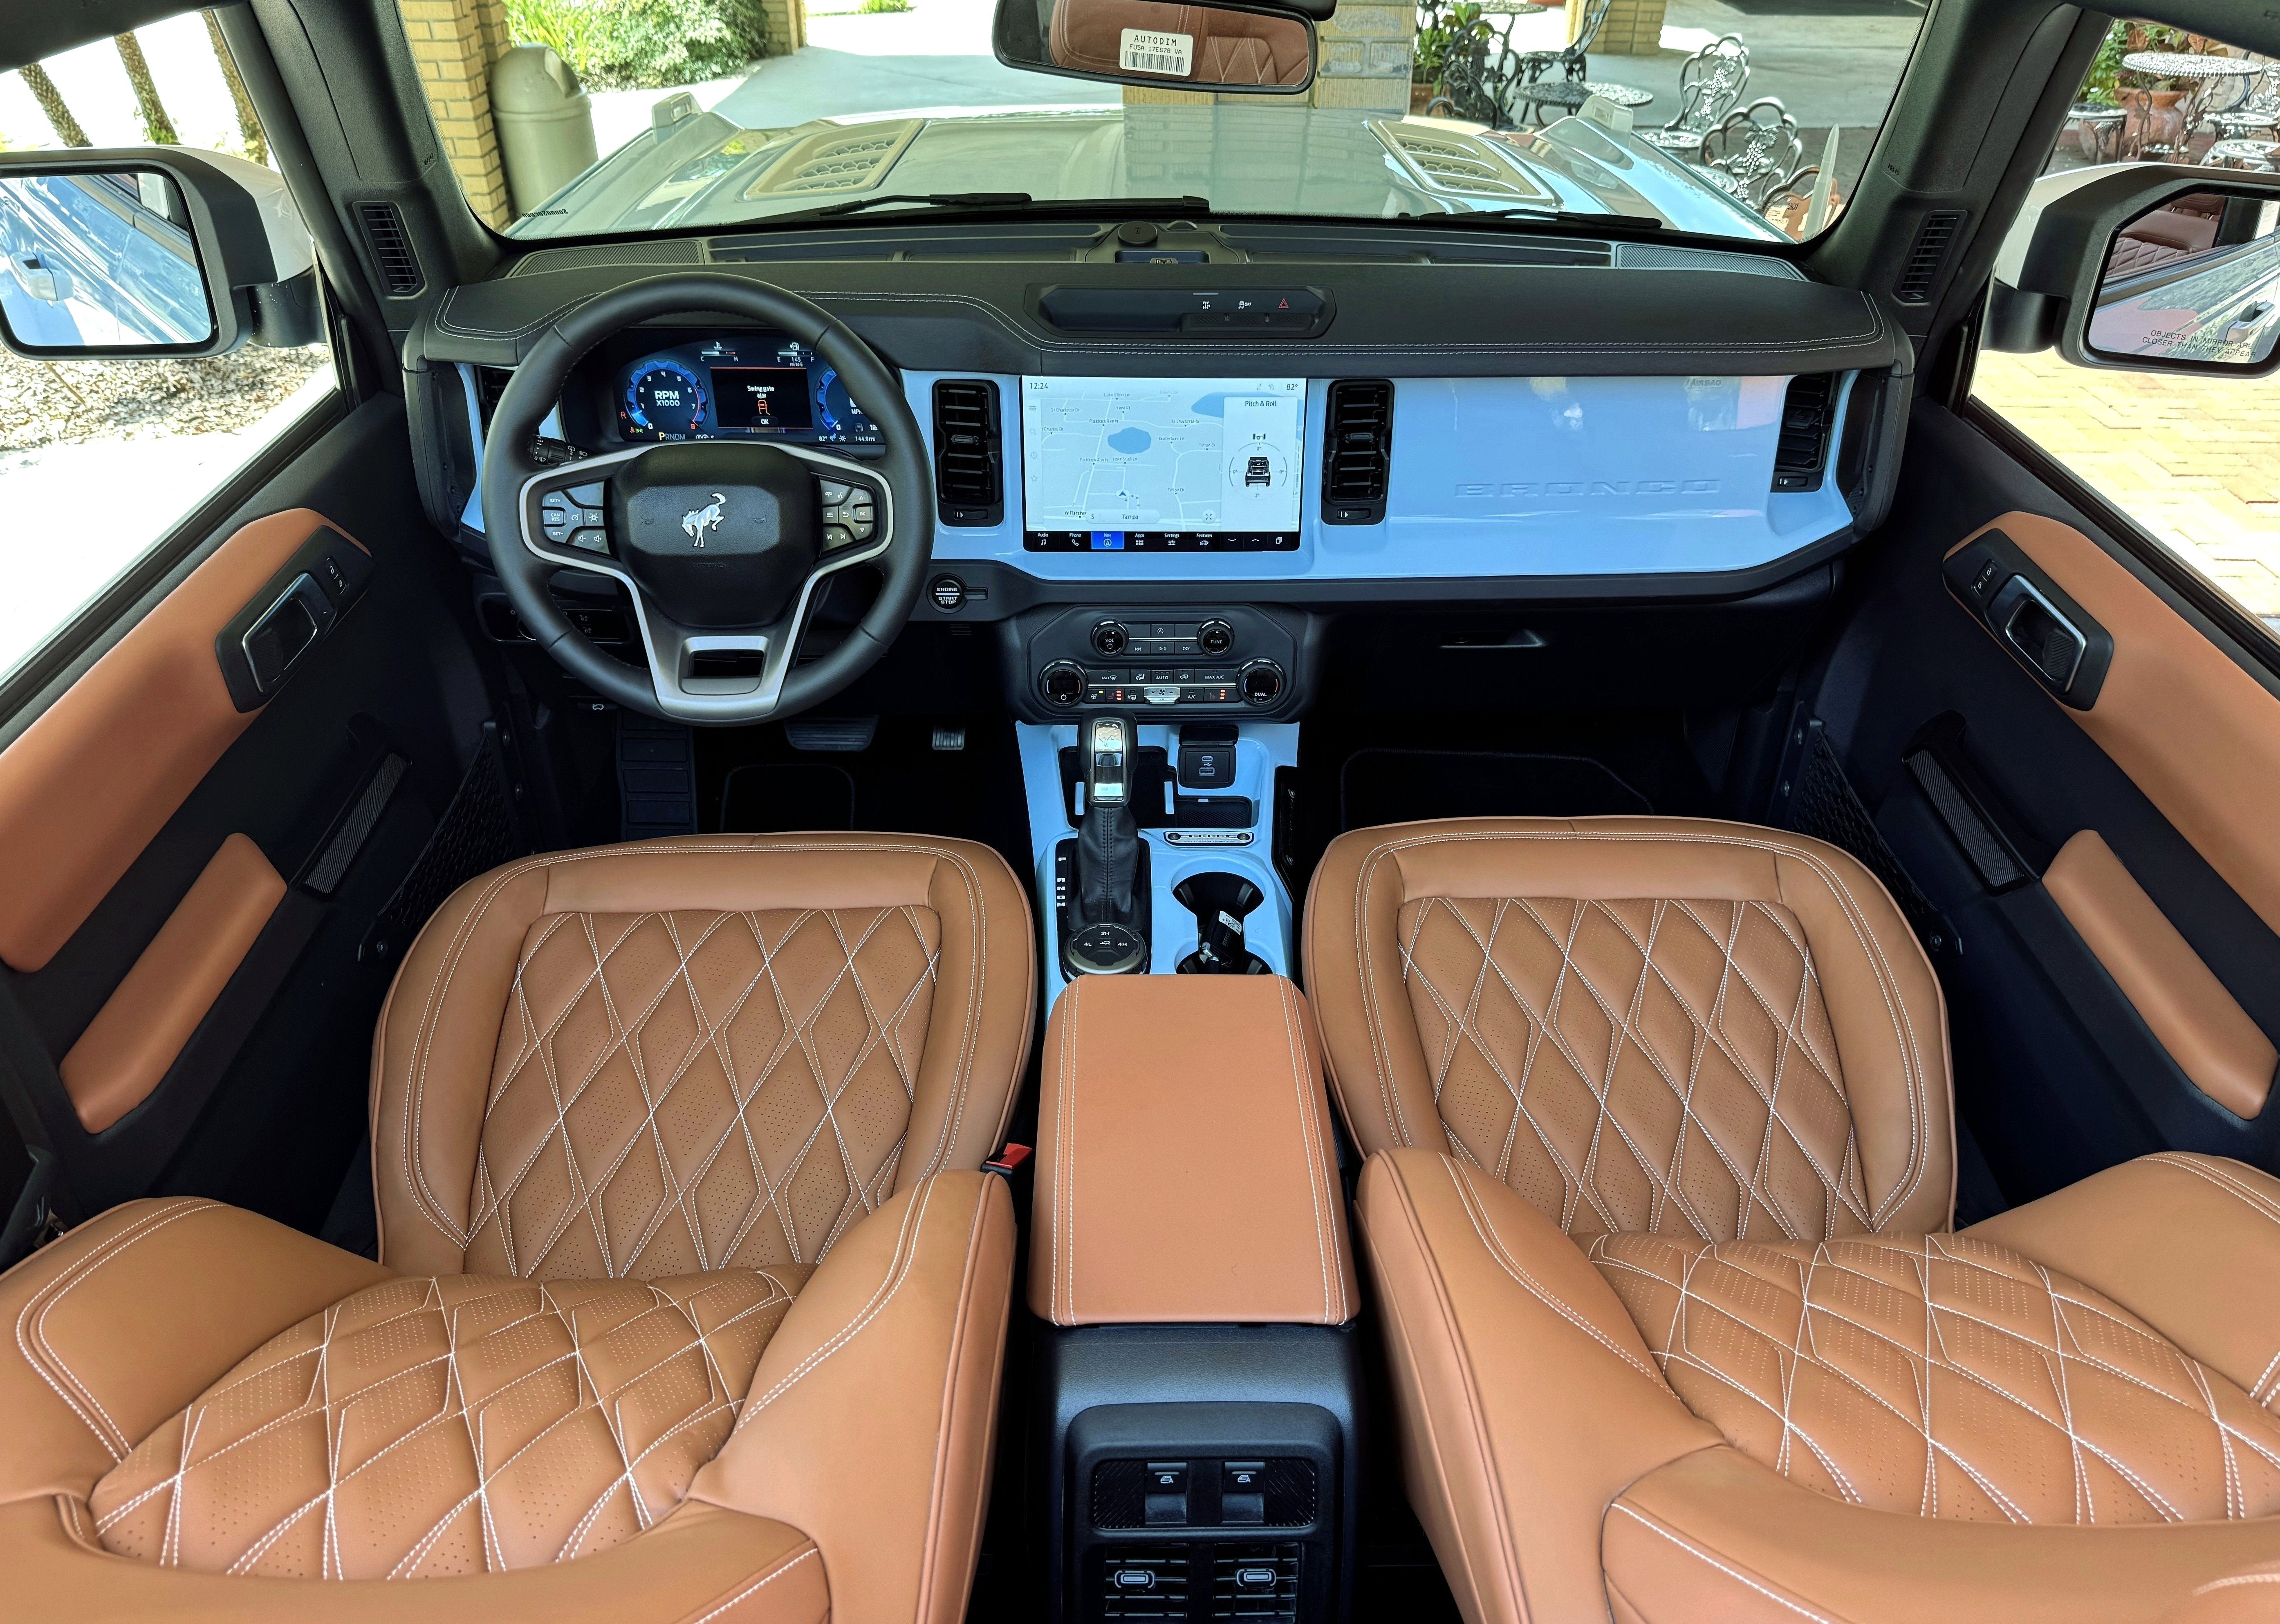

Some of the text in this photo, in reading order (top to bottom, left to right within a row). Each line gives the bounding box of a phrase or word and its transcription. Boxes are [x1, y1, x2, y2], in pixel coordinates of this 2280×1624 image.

[1134, 35, 1177, 46] AUTODIM
[2151, 330, 2186, 340] OBJECTS
[2203, 338, 2233, 347] MIRROR
[2142, 337, 2173, 347] CLOSER
[2177, 341, 2197, 350] THAN
[2225, 349, 2256, 358] APPEAR
[655, 390, 679, 400] RPM
[1455, 480, 1721, 498] BRONCO
